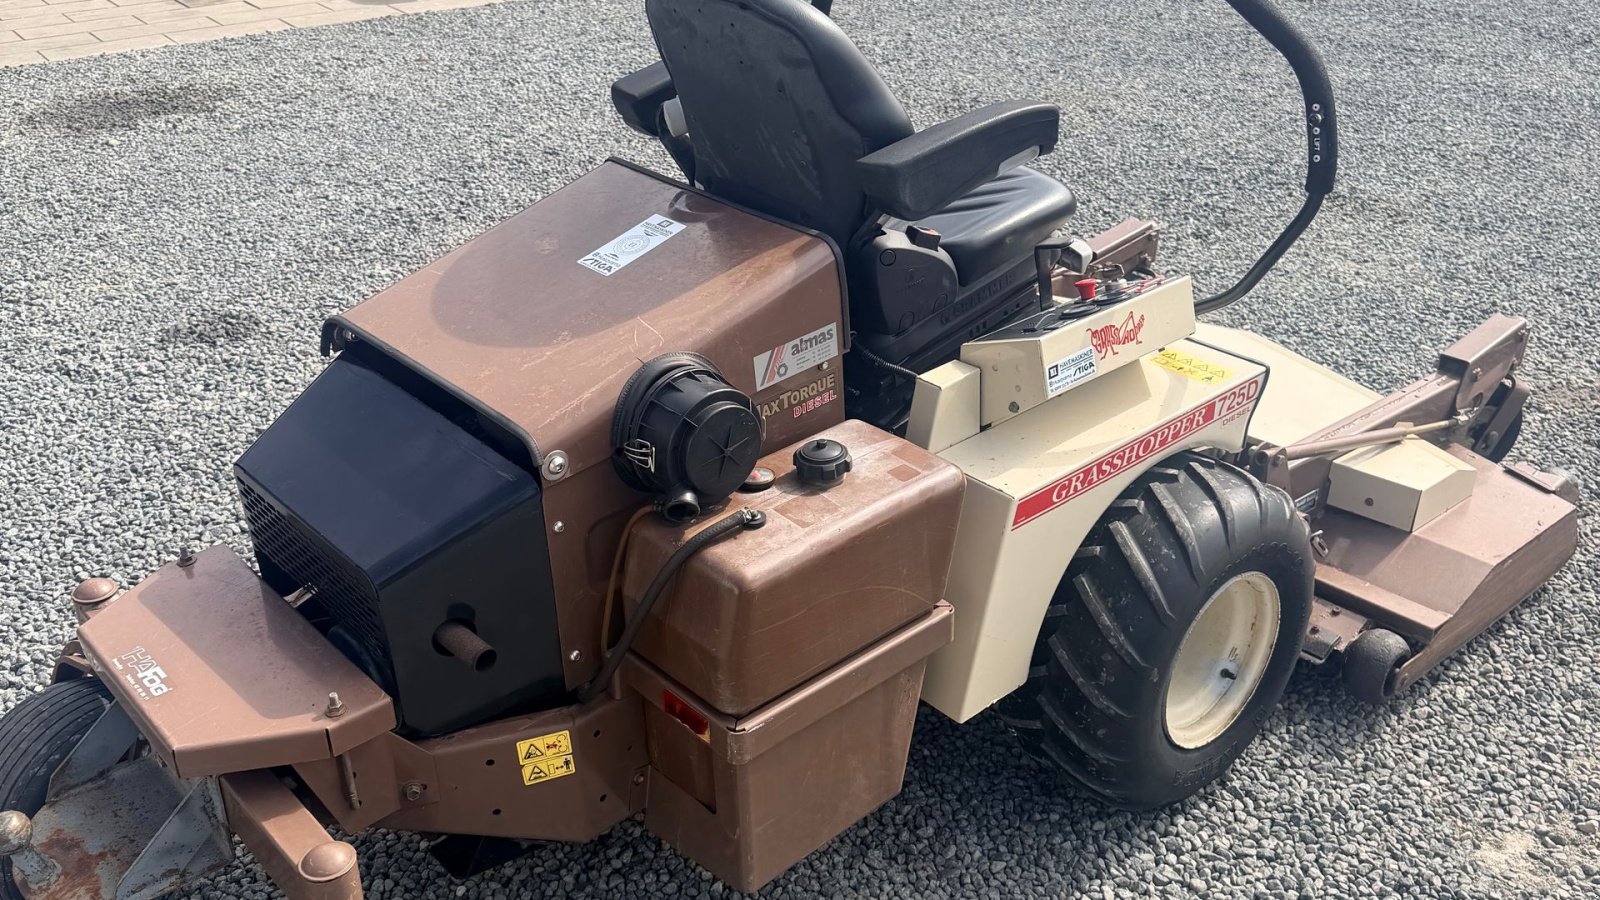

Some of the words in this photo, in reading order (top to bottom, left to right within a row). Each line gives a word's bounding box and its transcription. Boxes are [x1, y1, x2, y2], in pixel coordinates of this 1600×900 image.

[791, 328, 834, 356] almas
[793, 390, 838, 418] DIESEL
[1222, 406, 1251, 427] DIESEL
[1052, 406, 1207, 504] GRASSHOPPER
[1216, 379, 1259, 417] 725D
